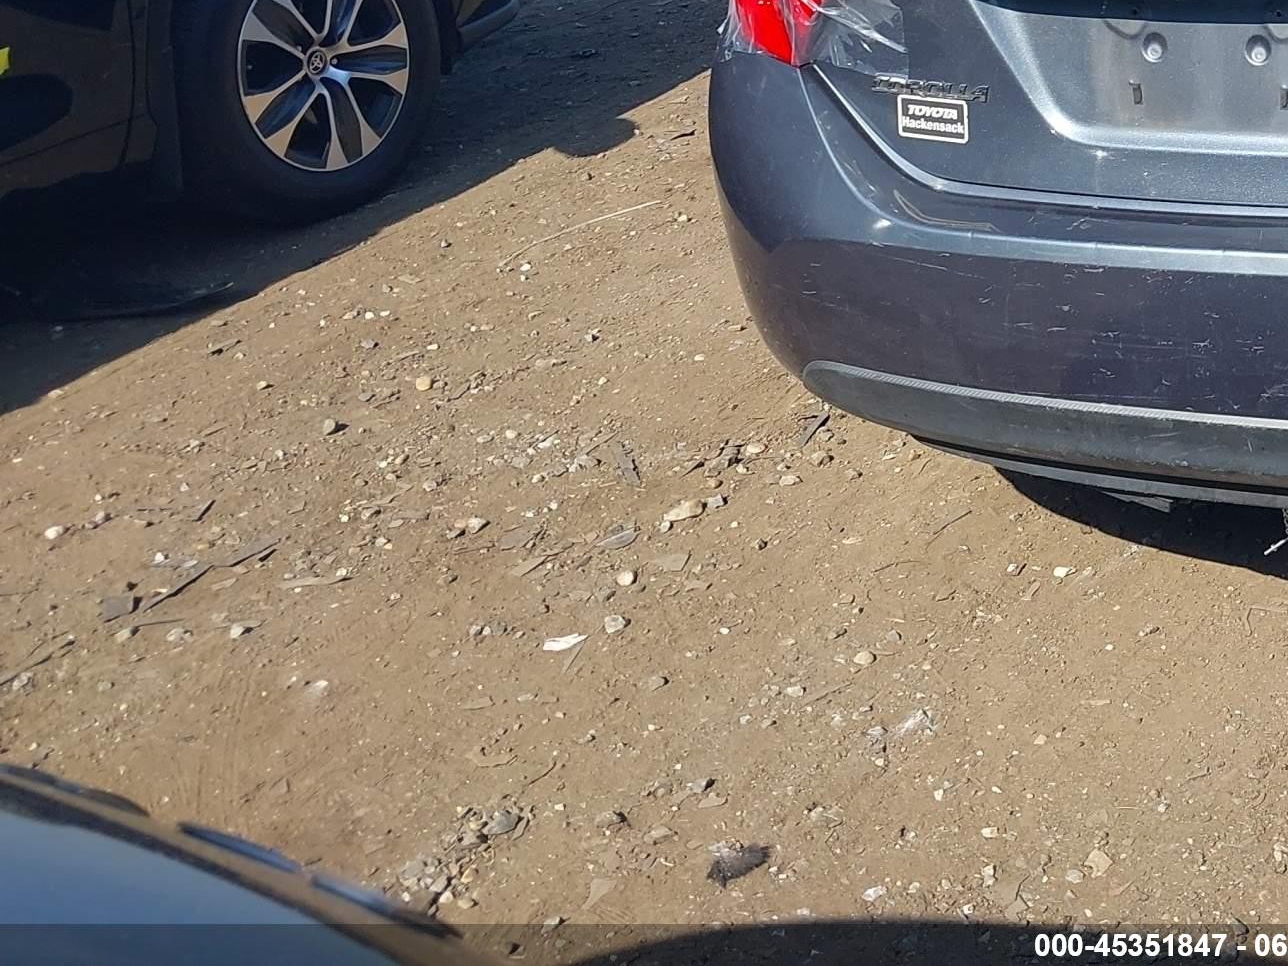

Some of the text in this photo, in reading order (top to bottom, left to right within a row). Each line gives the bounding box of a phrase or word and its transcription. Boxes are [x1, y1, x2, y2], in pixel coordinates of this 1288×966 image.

[871, 73, 990, 103] COROLLA
[907, 104, 958, 120] TOYOTA
[902, 115, 965, 134] Hackensack
